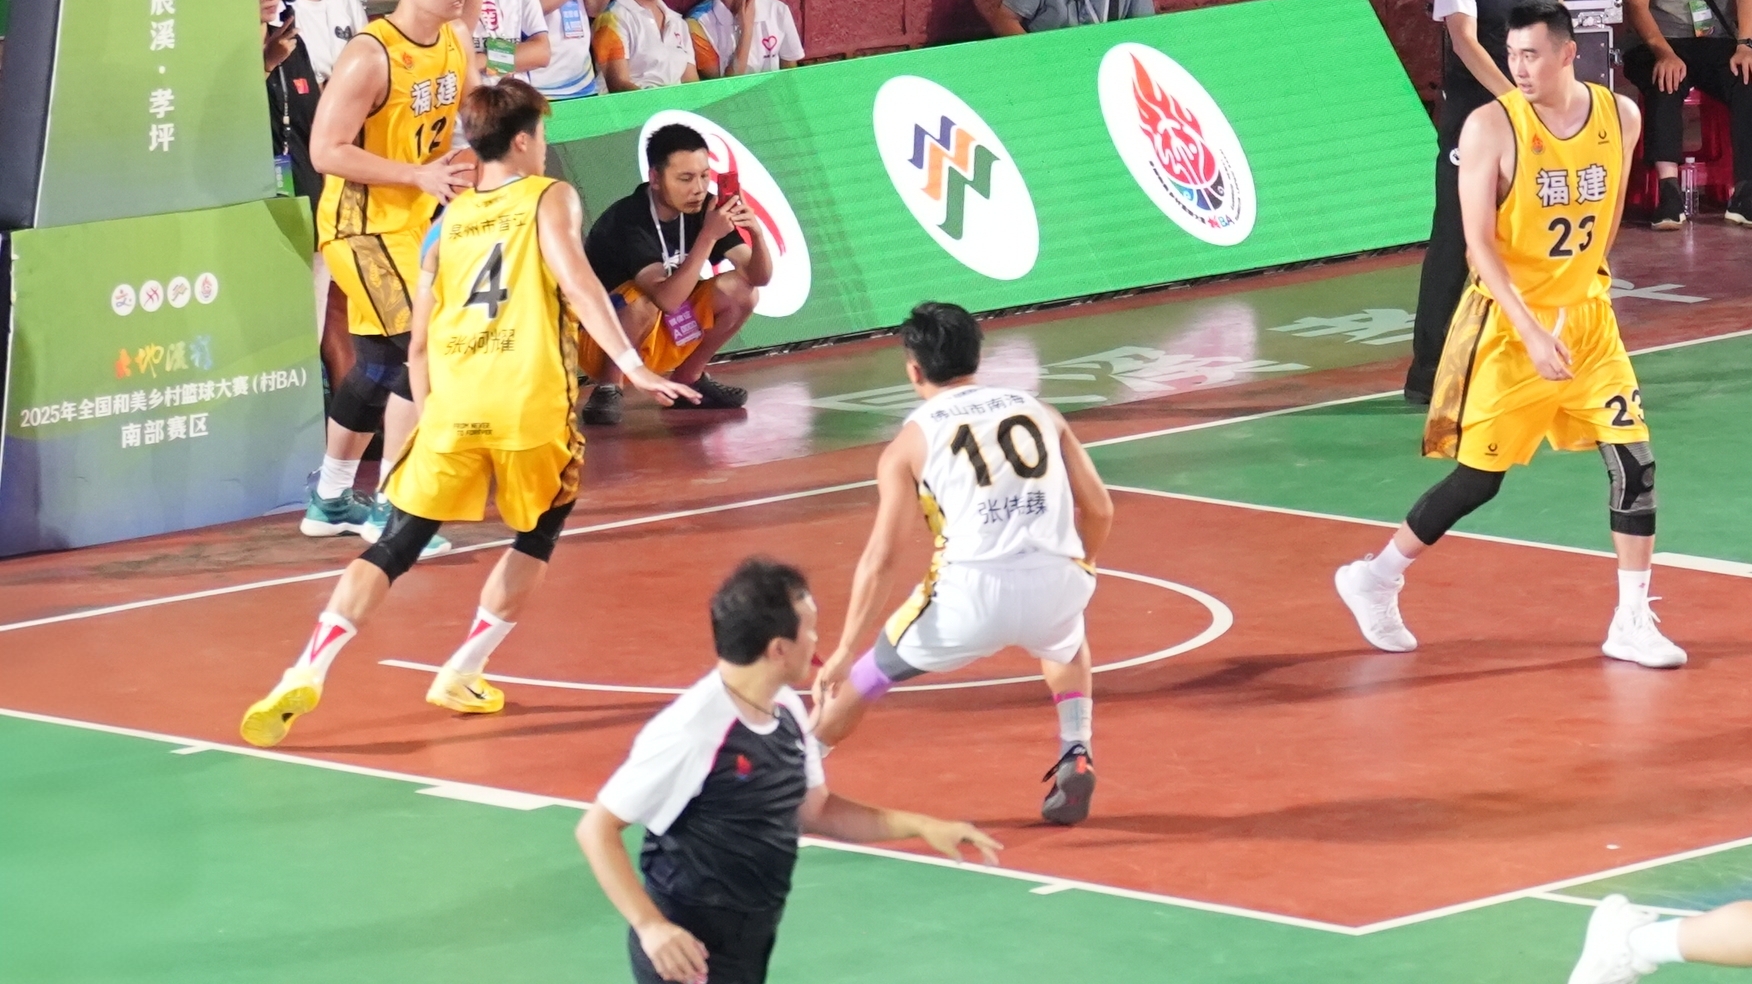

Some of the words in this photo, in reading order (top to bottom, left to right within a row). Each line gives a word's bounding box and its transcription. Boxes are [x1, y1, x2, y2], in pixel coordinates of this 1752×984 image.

[410, 69, 458, 117] 福建
[414, 116, 447, 159] 12
[1536, 163, 1608, 208] 福建
[1547, 215, 1597, 258] 23
[462, 242, 508, 320] 4
[121, 412, 209, 449] 南部赛区
[951, 414, 1048, 487] 10
